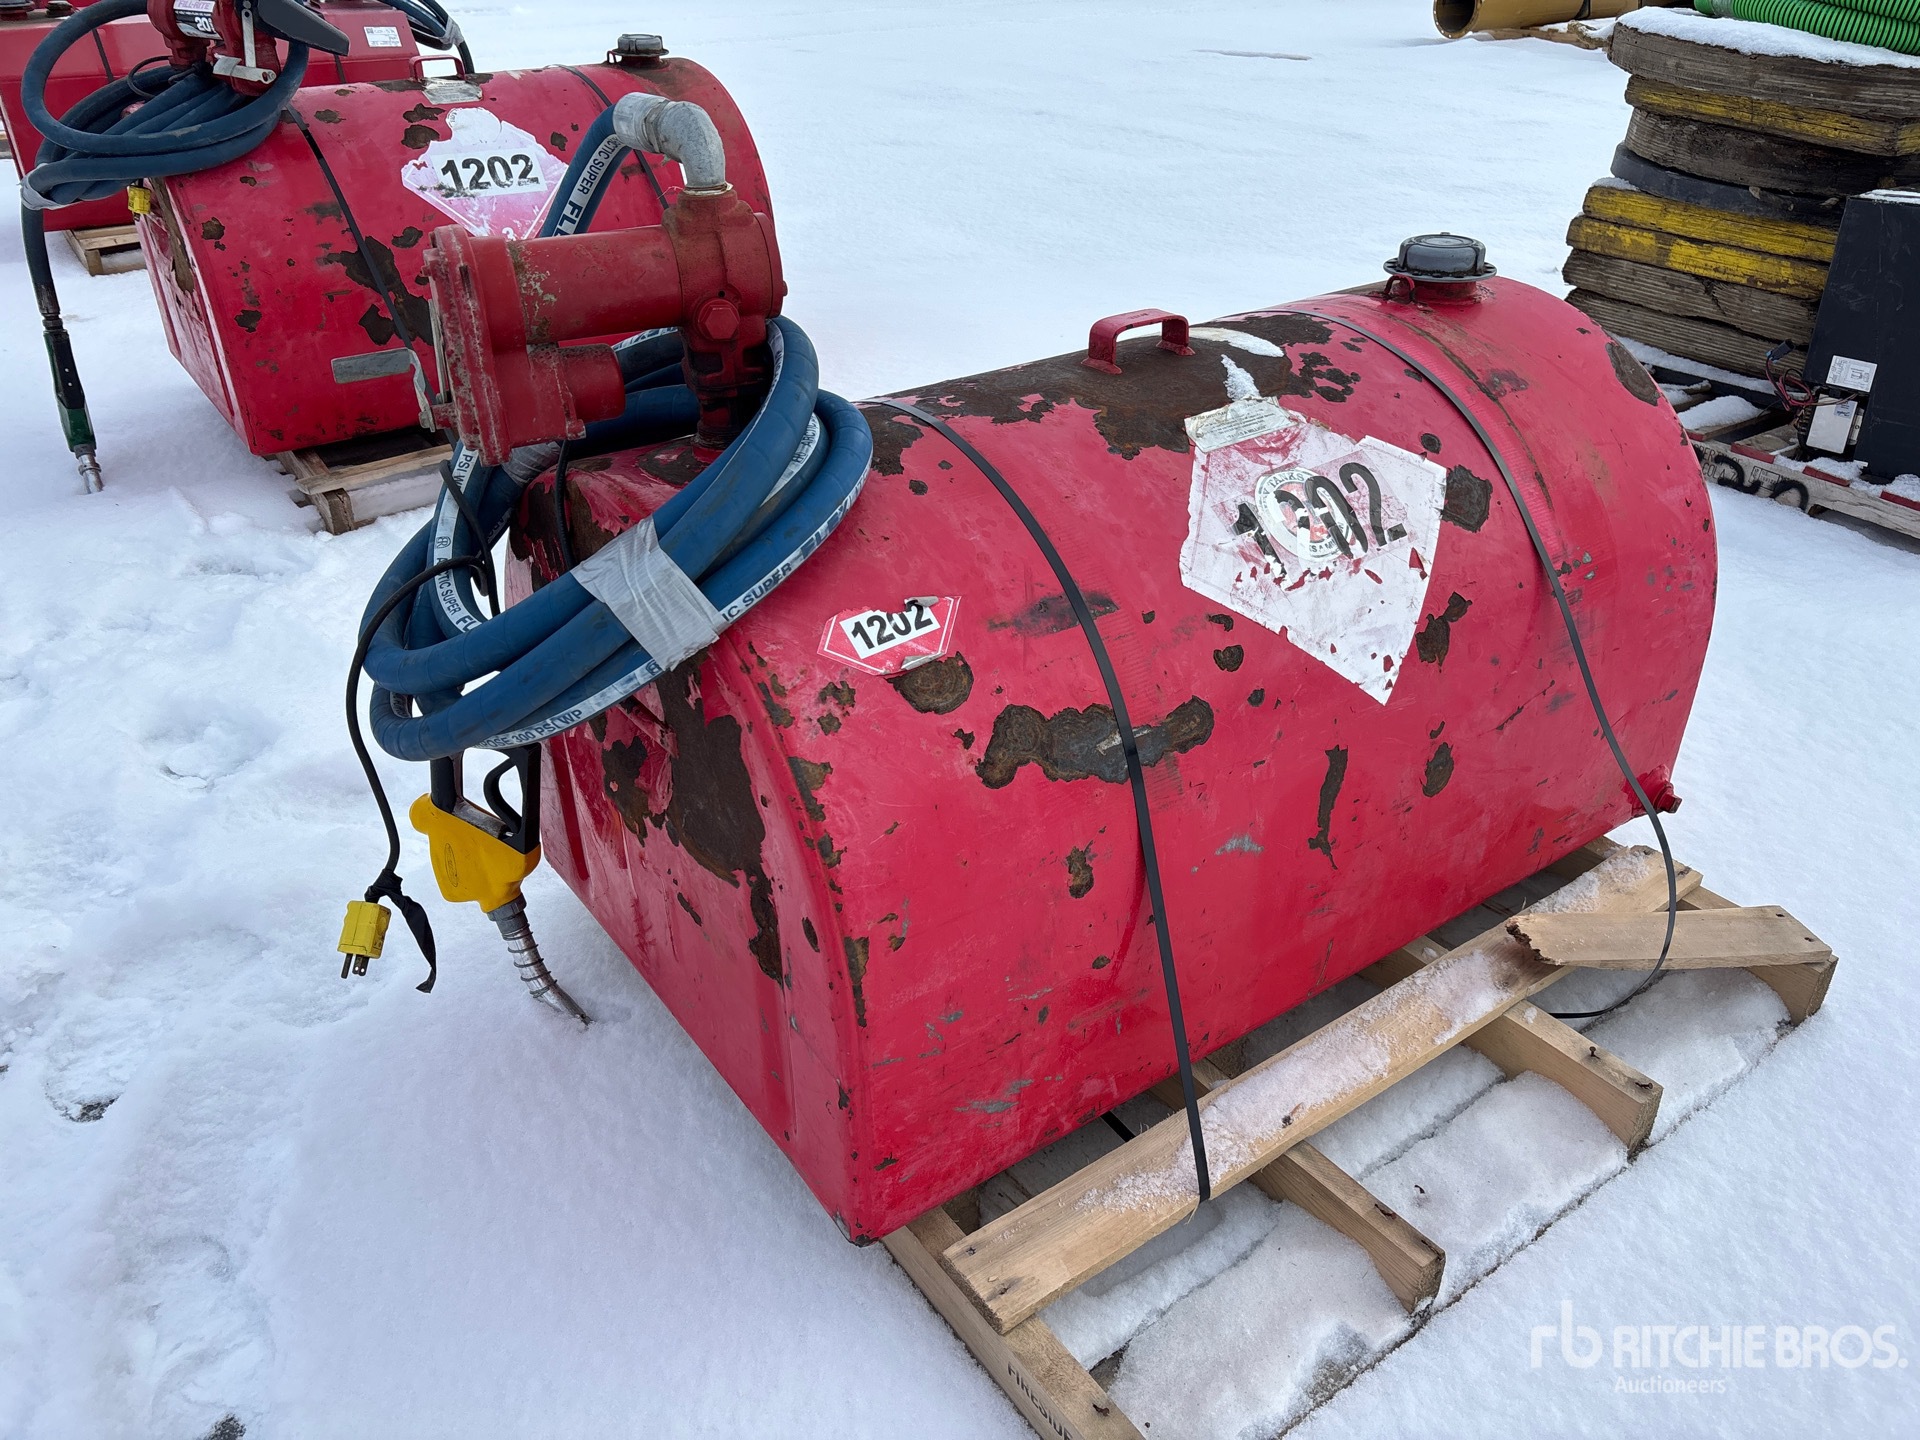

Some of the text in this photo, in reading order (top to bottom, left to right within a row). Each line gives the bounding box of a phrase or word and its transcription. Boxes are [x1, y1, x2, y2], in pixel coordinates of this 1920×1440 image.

[178, 0, 211, 10] FILL-RITE
[194, 16, 211, 32] 20
[441, 154, 540, 191] 1202
[577, 158, 605, 196] SUPER
[456, 453, 473, 473] PSI
[1267, 472, 1305, 489] TANKS
[440, 584, 462, 616] SUPER
[743, 562, 793, 606] SUPER
[851, 599, 934, 650] 1202
[511, 731, 536, 743] 300
[536, 719, 558, 737] PSI
[557, 709, 583, 728] WP
